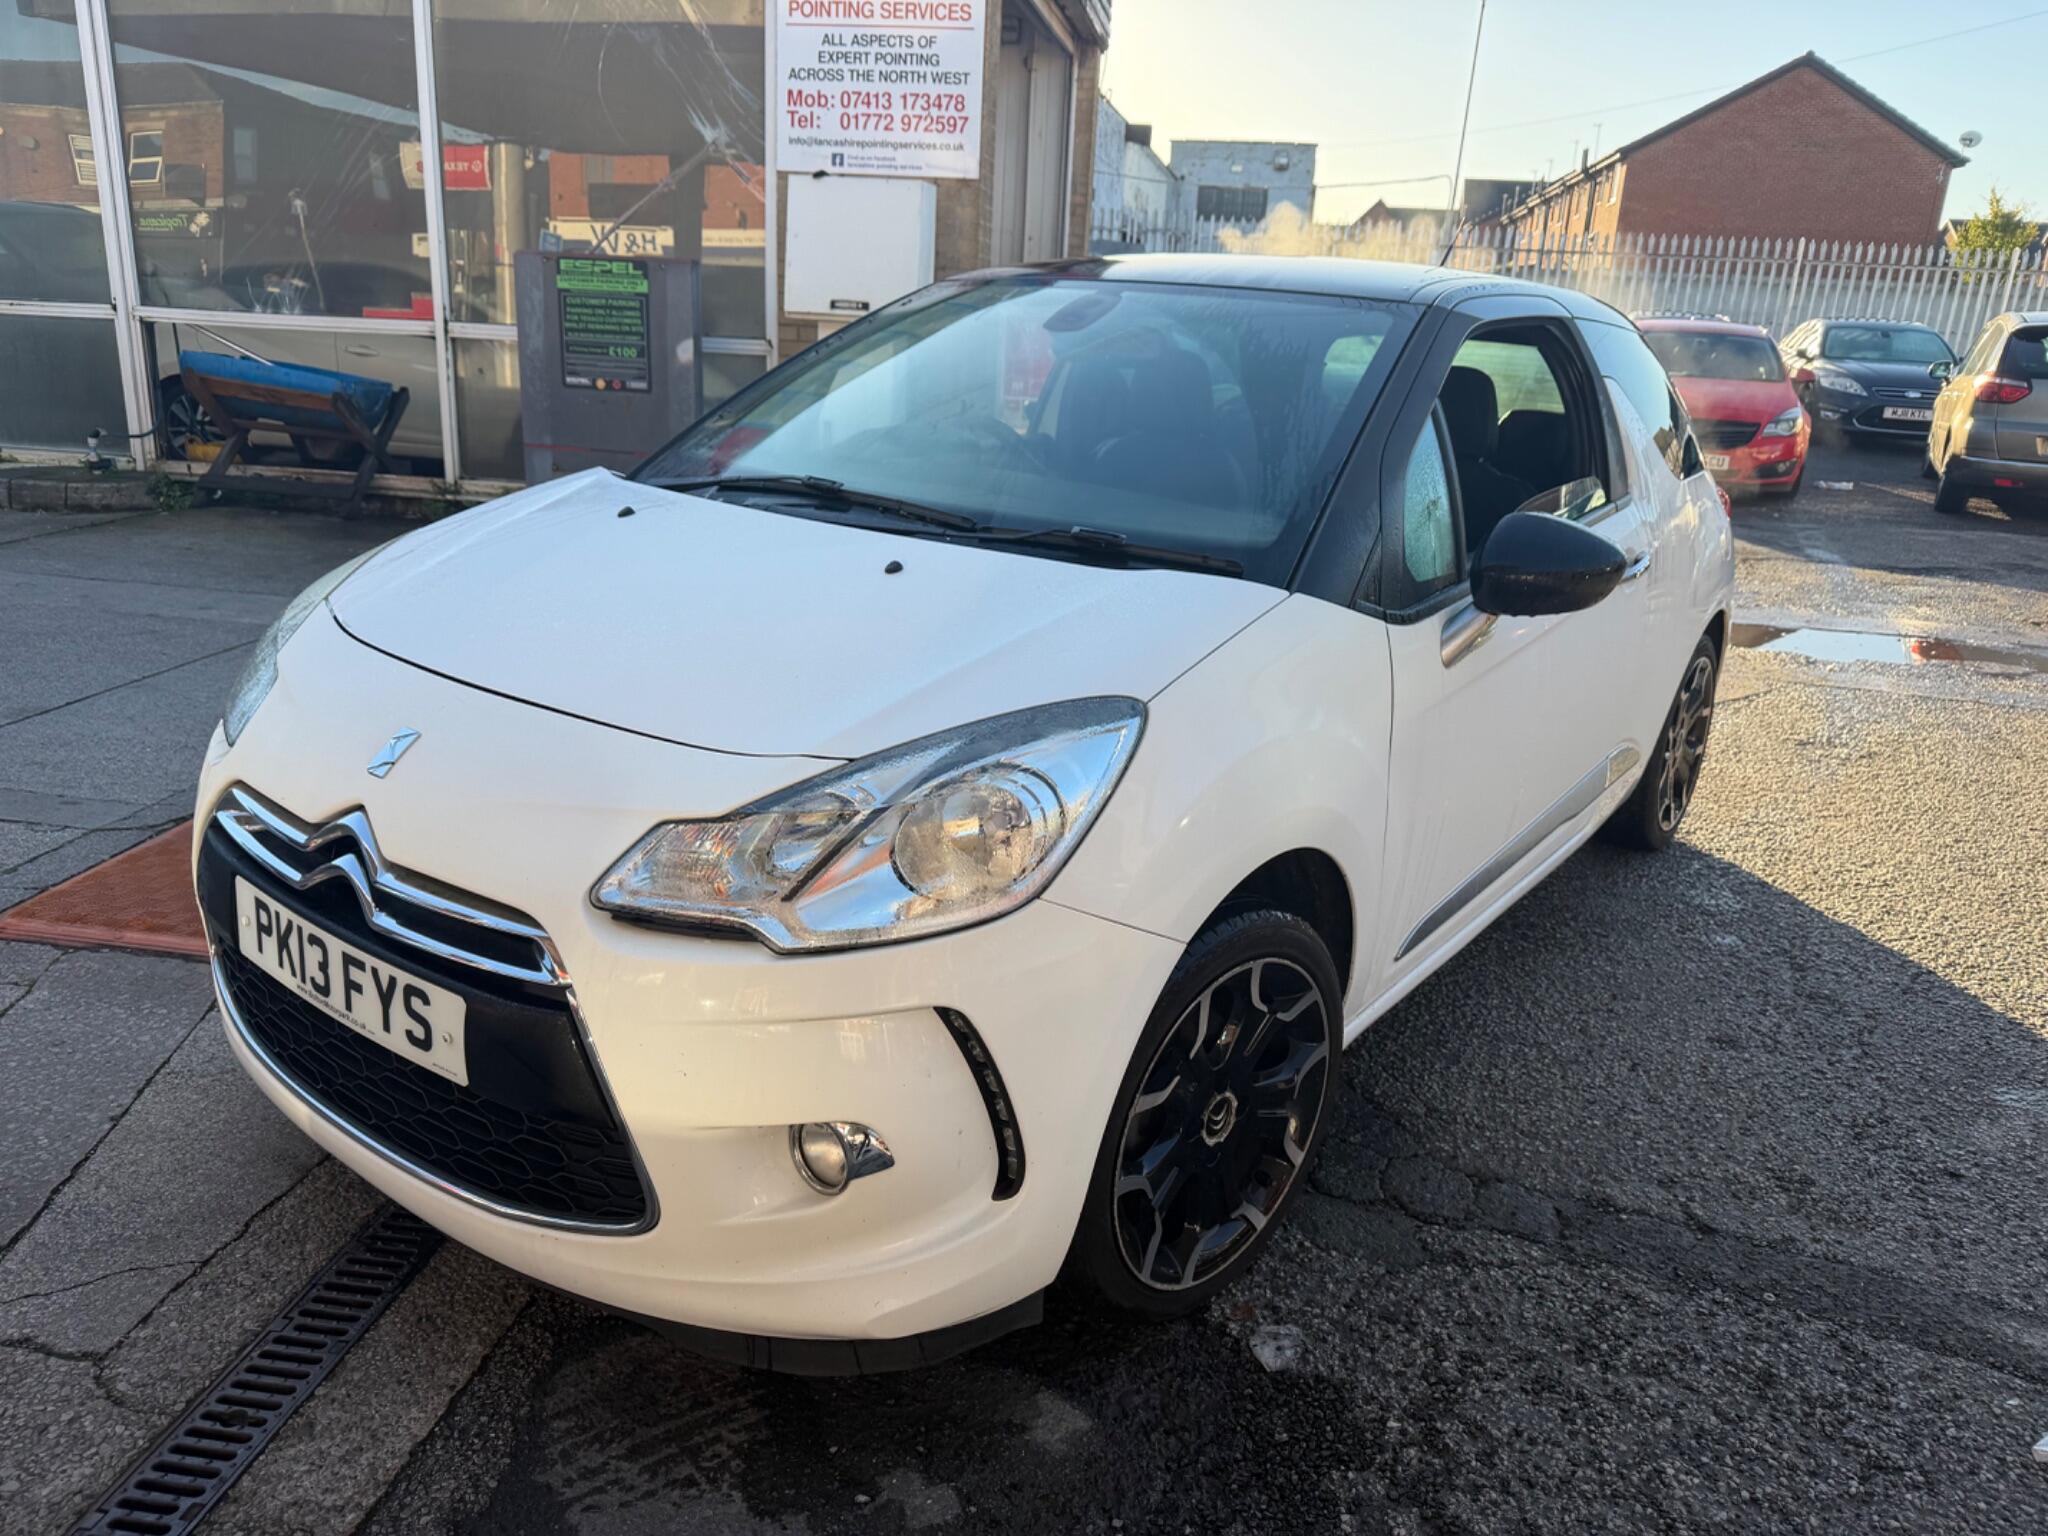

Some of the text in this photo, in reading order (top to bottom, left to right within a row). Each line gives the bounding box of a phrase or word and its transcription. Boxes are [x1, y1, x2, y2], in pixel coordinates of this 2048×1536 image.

[788, 0, 972, 22] POINTING SERVICES
[821, 33, 938, 49] ALL ASPECTS OF
[818, 51, 941, 67] EXPERT POINTING
[788, 68, 971, 85] ACROSS THE NORTH WEST
[787, 89, 966, 113] Mob: 07413 173478
[787, 110, 969, 135] Tel: 01772 972597
[788, 135, 965, 151] info@lancashirepointingservices.co.uk
[608, 345, 638, 359] £100
[254, 895, 331, 999] PK13
[342, 950, 433, 1053] FYS
